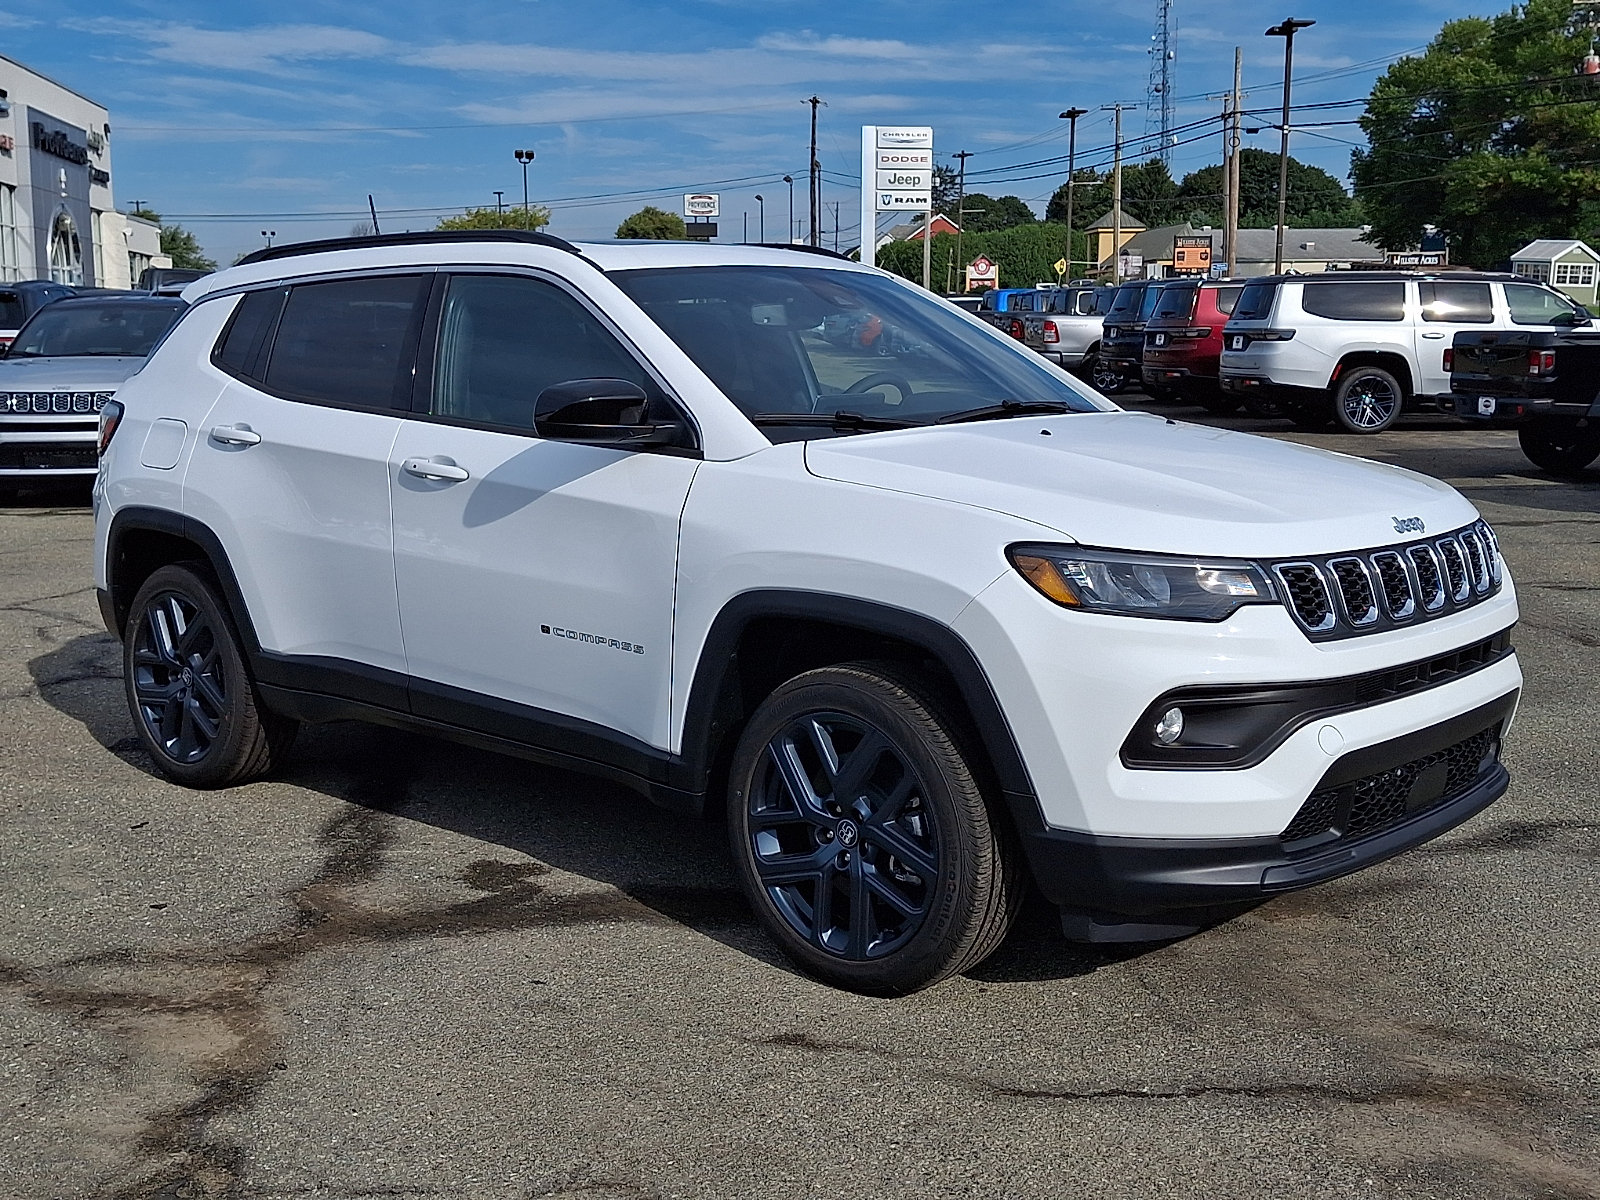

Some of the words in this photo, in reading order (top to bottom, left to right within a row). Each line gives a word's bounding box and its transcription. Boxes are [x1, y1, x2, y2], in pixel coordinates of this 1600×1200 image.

[888, 172, 921, 187] Jeep
[1391, 516, 1425, 534] Jeep
[552, 626, 645, 655] COMPASS
